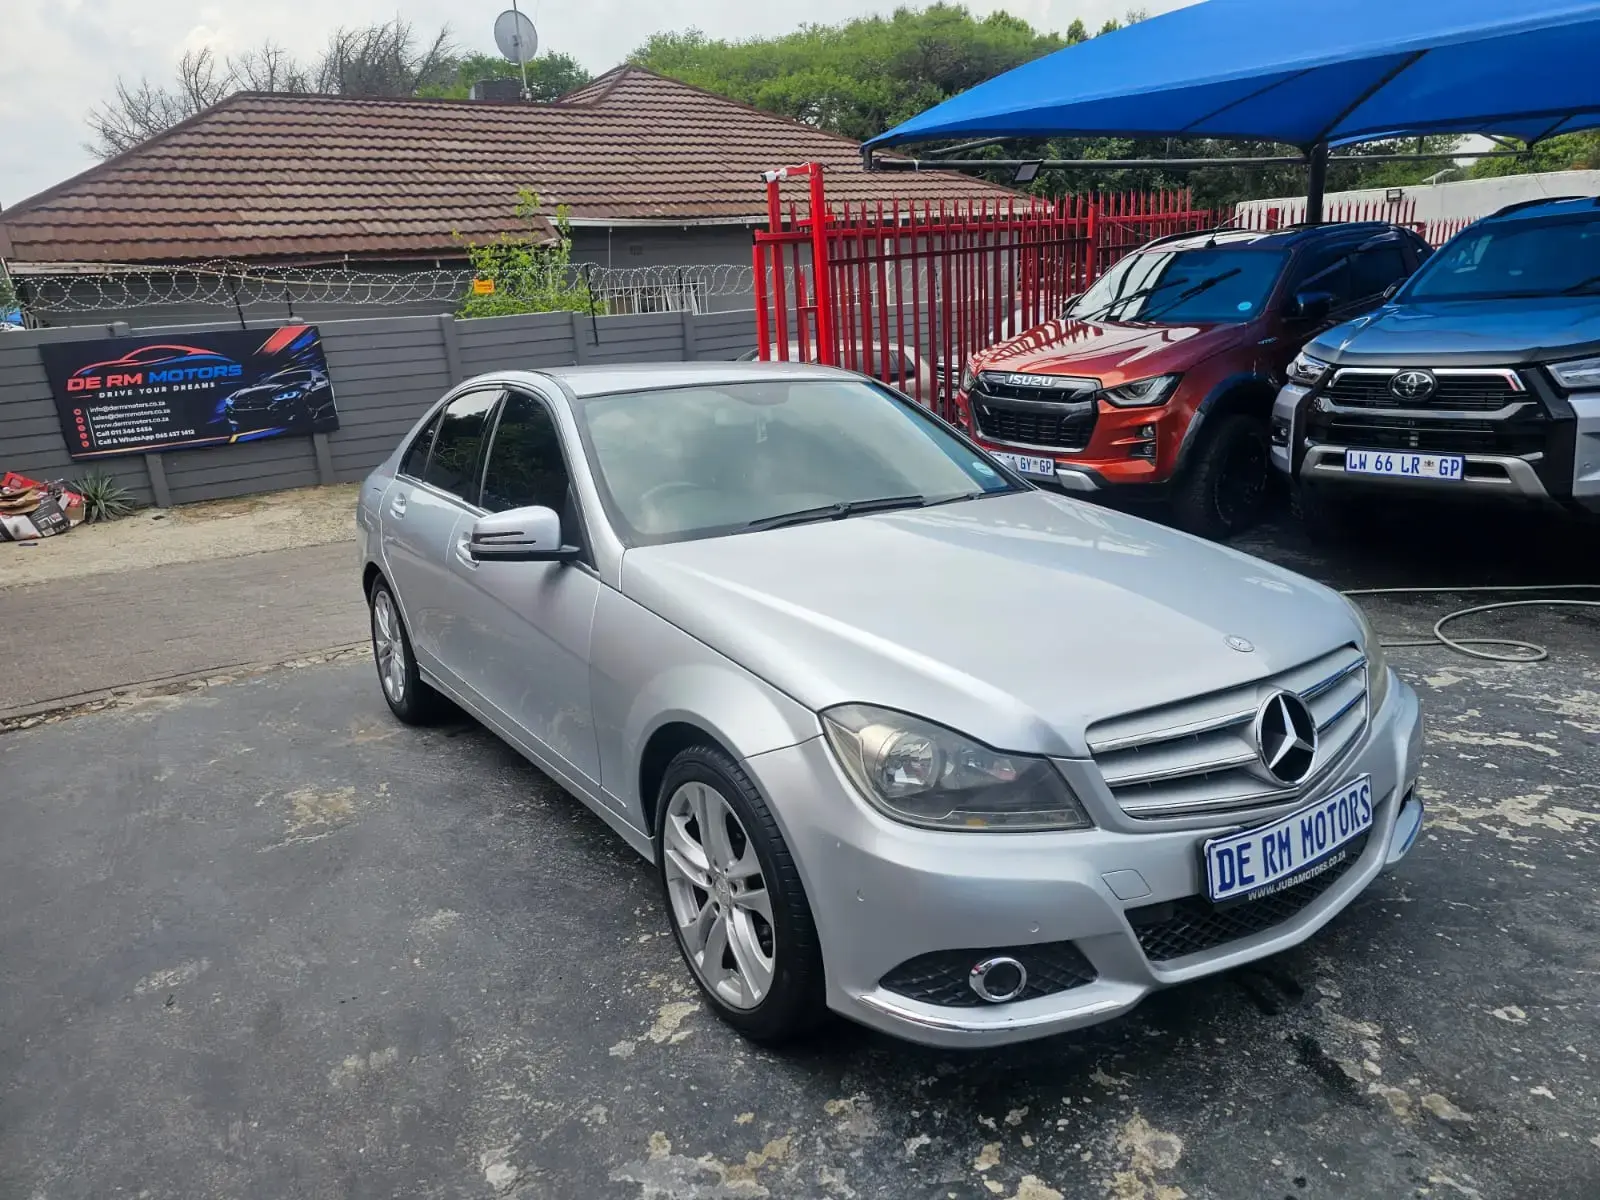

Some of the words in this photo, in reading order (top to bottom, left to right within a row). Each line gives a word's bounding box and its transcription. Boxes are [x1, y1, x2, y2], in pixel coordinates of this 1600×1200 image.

[67, 376, 101, 391] DE
[106, 373, 142, 388] RM
[148, 364, 243, 384] MOTORS
[1008, 374, 1053, 386] ISUZU
[98, 389, 133, 399] DRIVE
[139, 386, 168, 395] YOUR
[173, 382, 216, 392] DREAMS
[118, 434, 155, 444] WhatsApp
[1020, 456, 1031, 471] GY
[1039, 459, 1052, 474] GP
[1348, 453, 1367, 470] LW
[1374, 454, 1393, 472] 66
[1401, 457, 1420, 474] LR
[1439, 458, 1461, 477] GP
[1216, 842, 1255, 893] DE
[1261, 824, 1293, 878] RM
[1300, 784, 1371, 860] MOTORS
